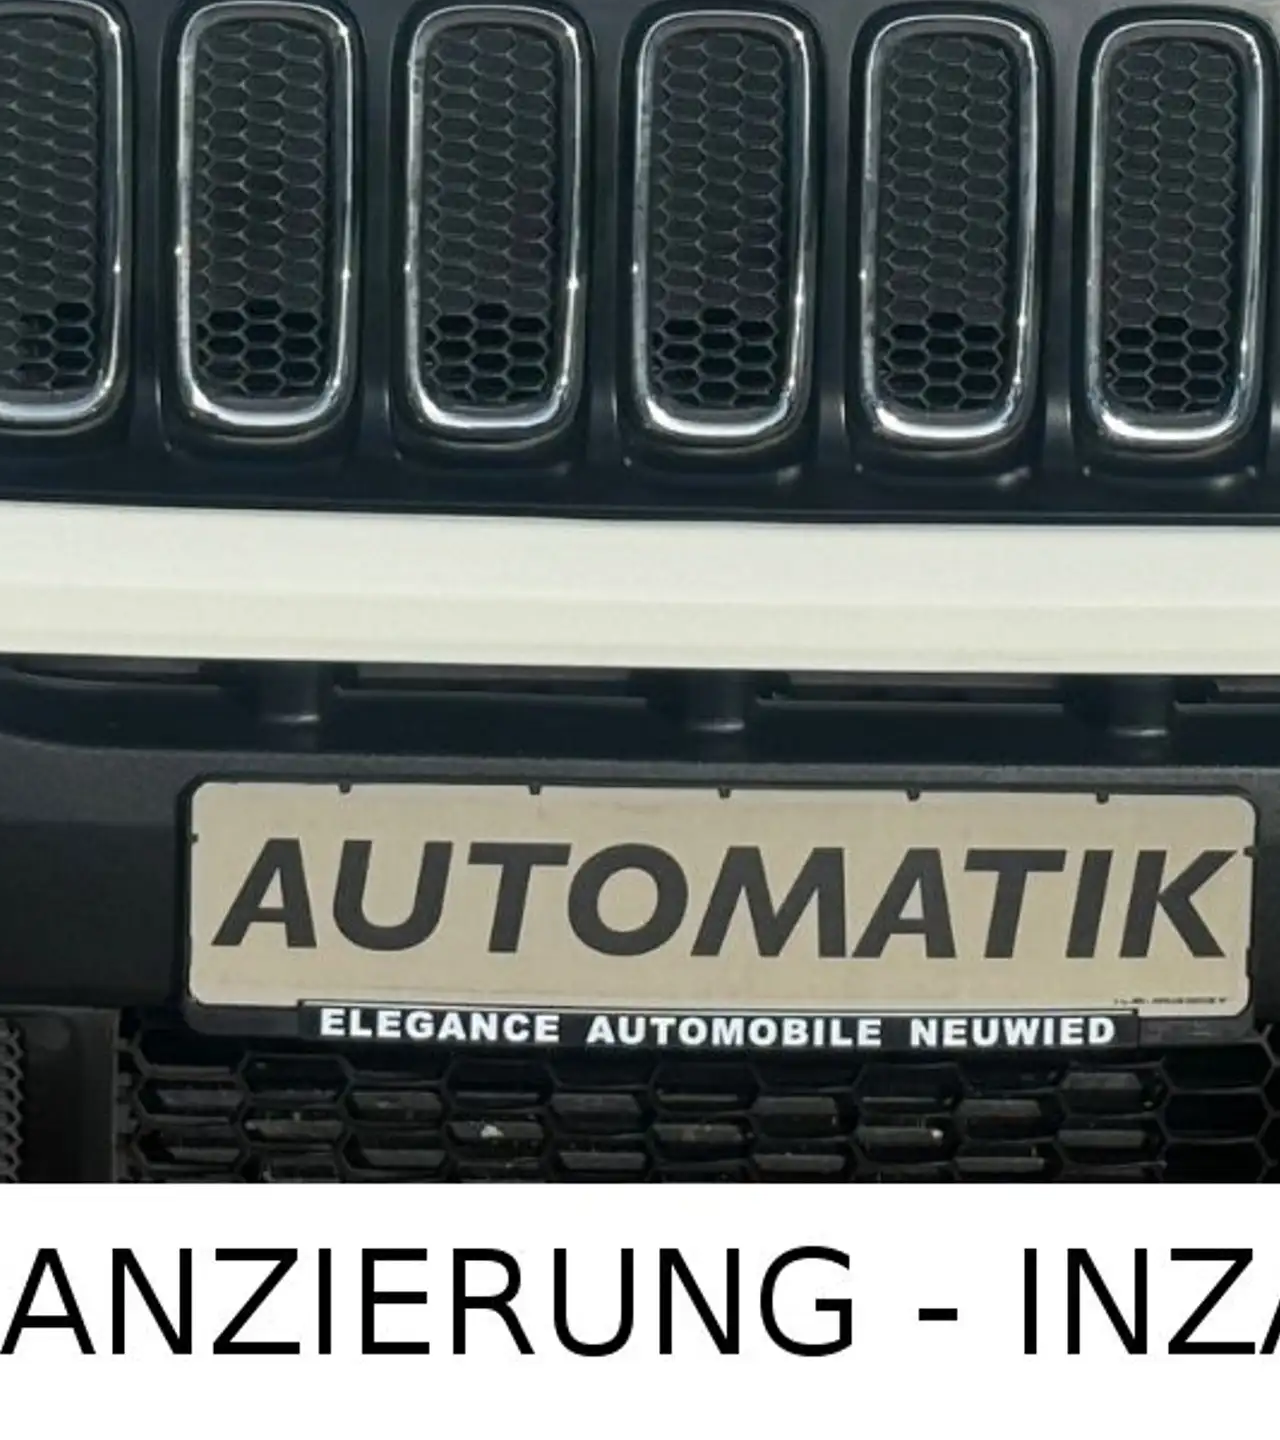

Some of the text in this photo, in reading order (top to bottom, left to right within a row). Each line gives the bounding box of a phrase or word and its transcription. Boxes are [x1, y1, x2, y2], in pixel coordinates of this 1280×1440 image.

[211, 837, 1239, 959] AUTOMATIK
[320, 1008, 1116, 1047] ELEGANCE AUTOMOBILE NEUWIED
